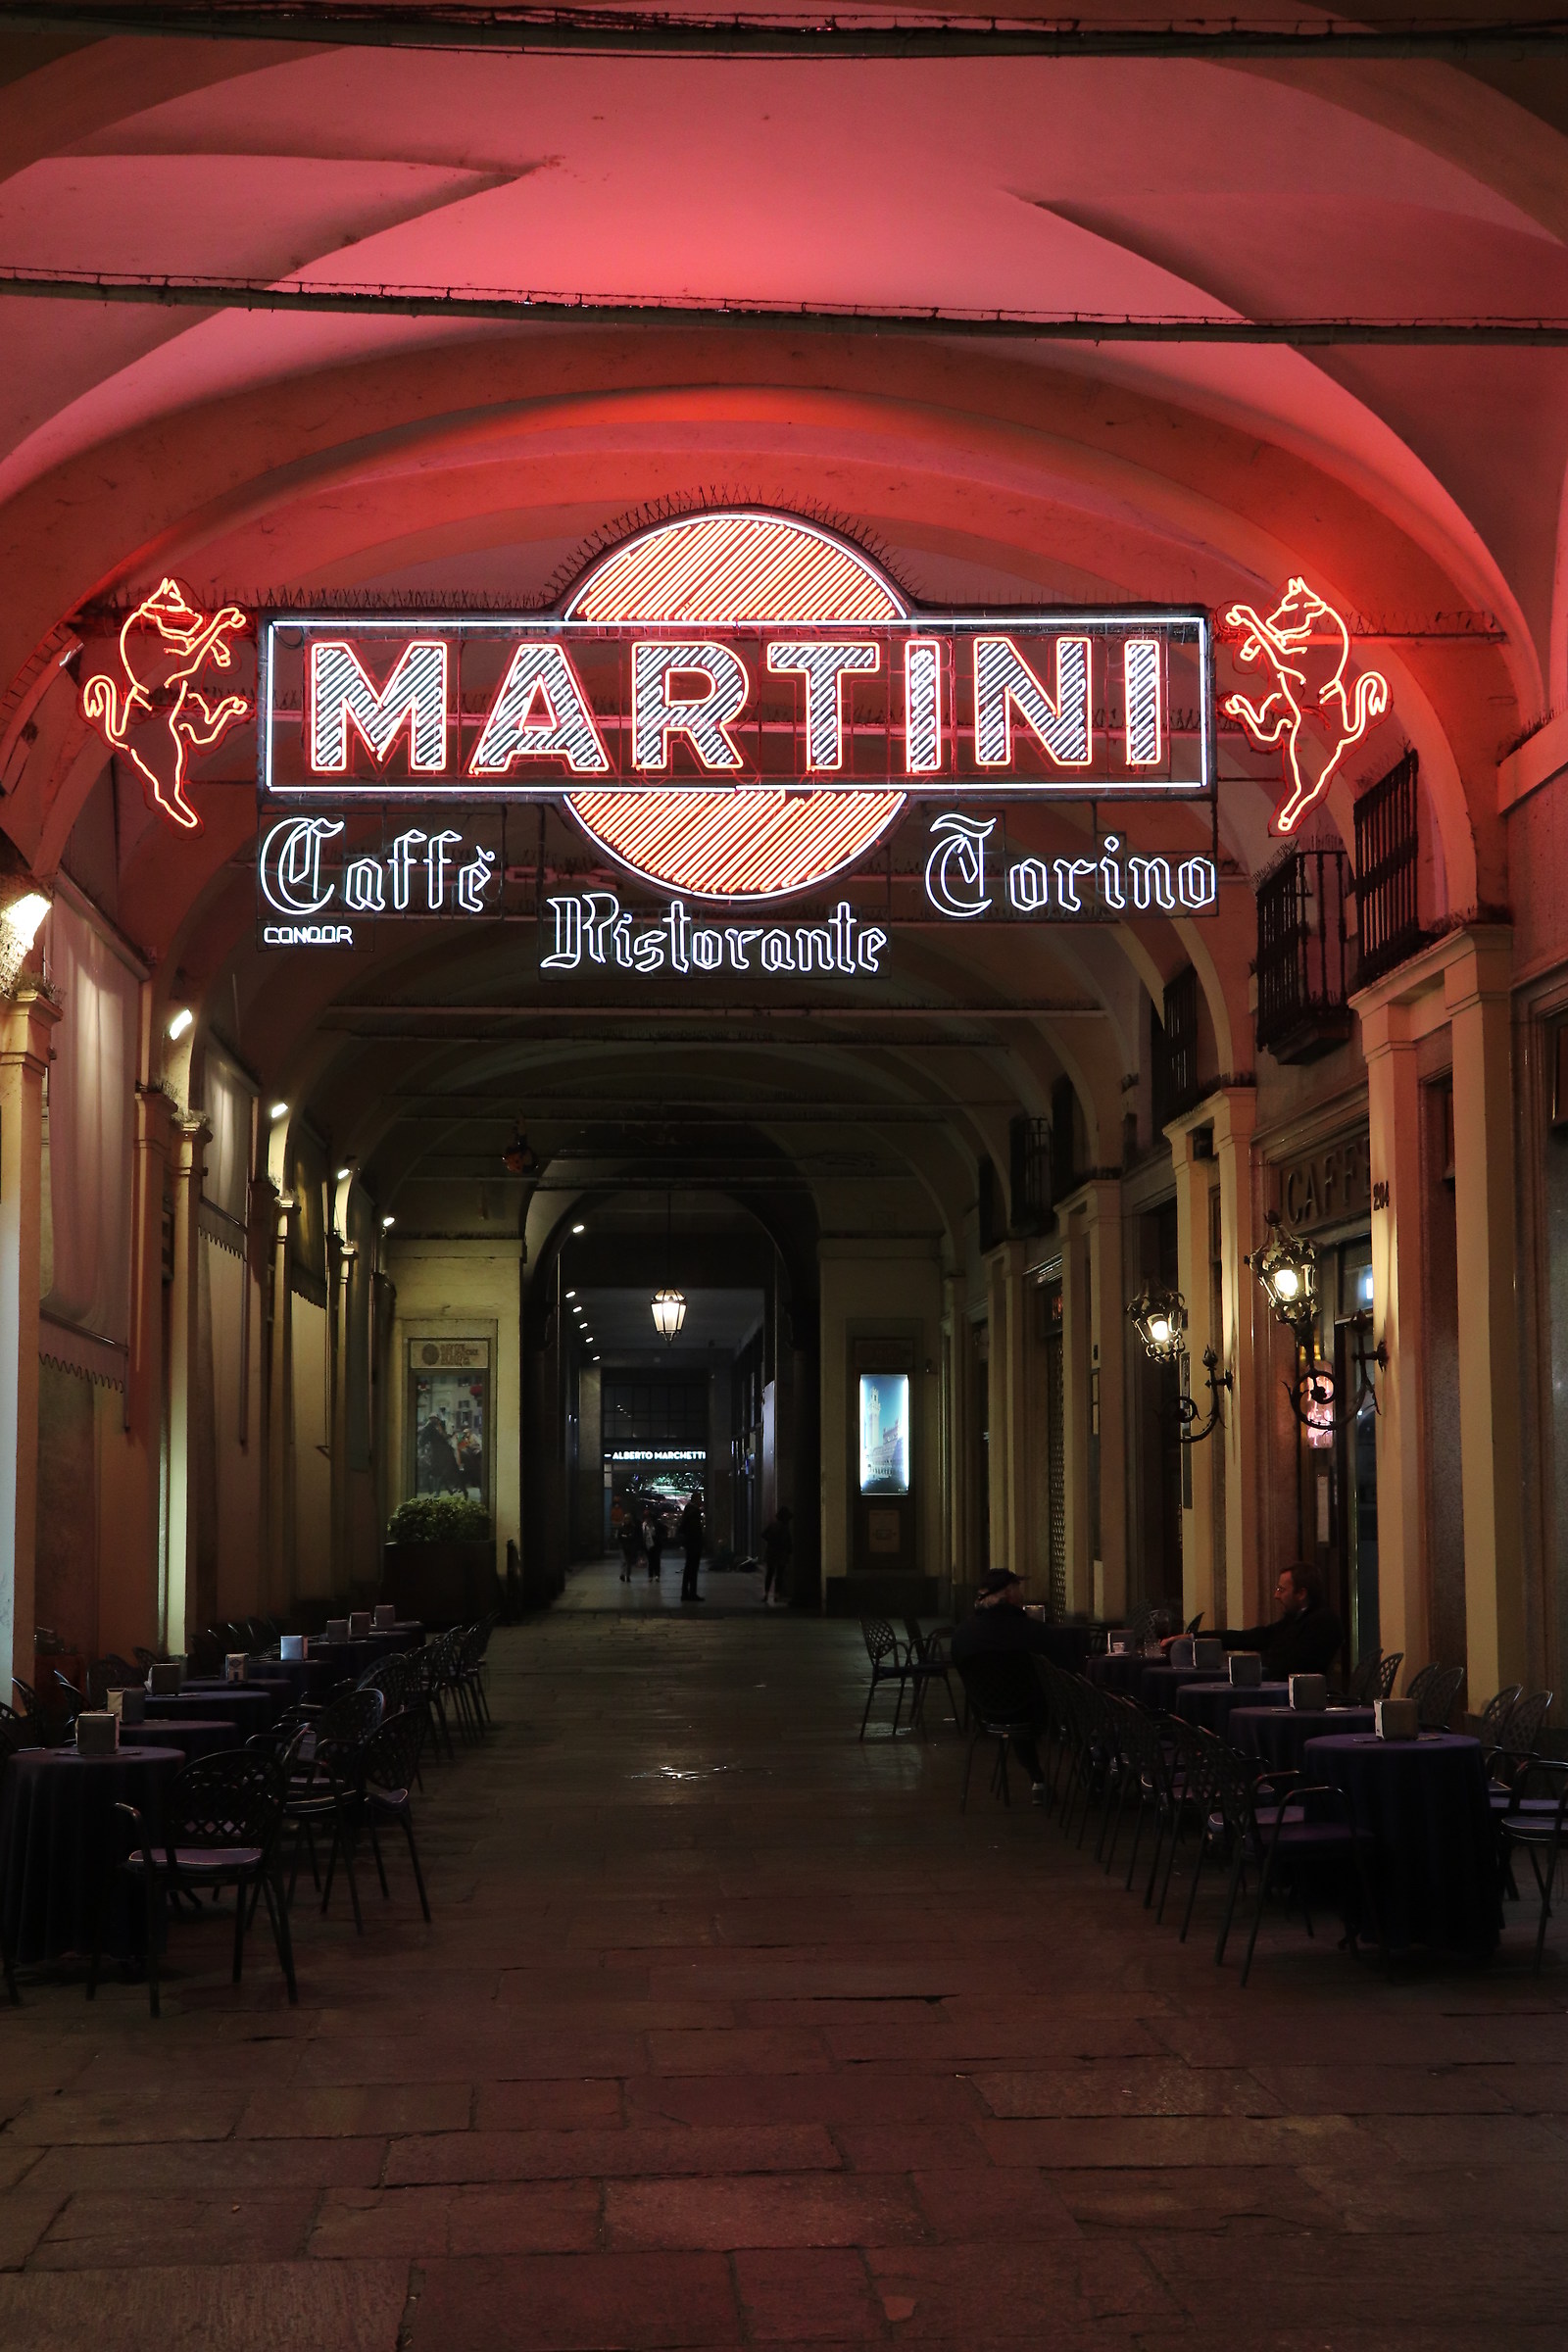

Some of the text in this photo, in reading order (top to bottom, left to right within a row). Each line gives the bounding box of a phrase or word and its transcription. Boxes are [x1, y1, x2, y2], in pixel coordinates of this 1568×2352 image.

[308, 633, 1163, 775] MARTINI
[260, 812, 1217, 918] Caffè Torino
[263, 925, 354, 946] CONDOR
[539, 892, 888, 973] Ristorante
[1288, 1137, 1370, 1225] CAFF
[612, 1450, 707, 1460] ALBERTO MARCHETTI
